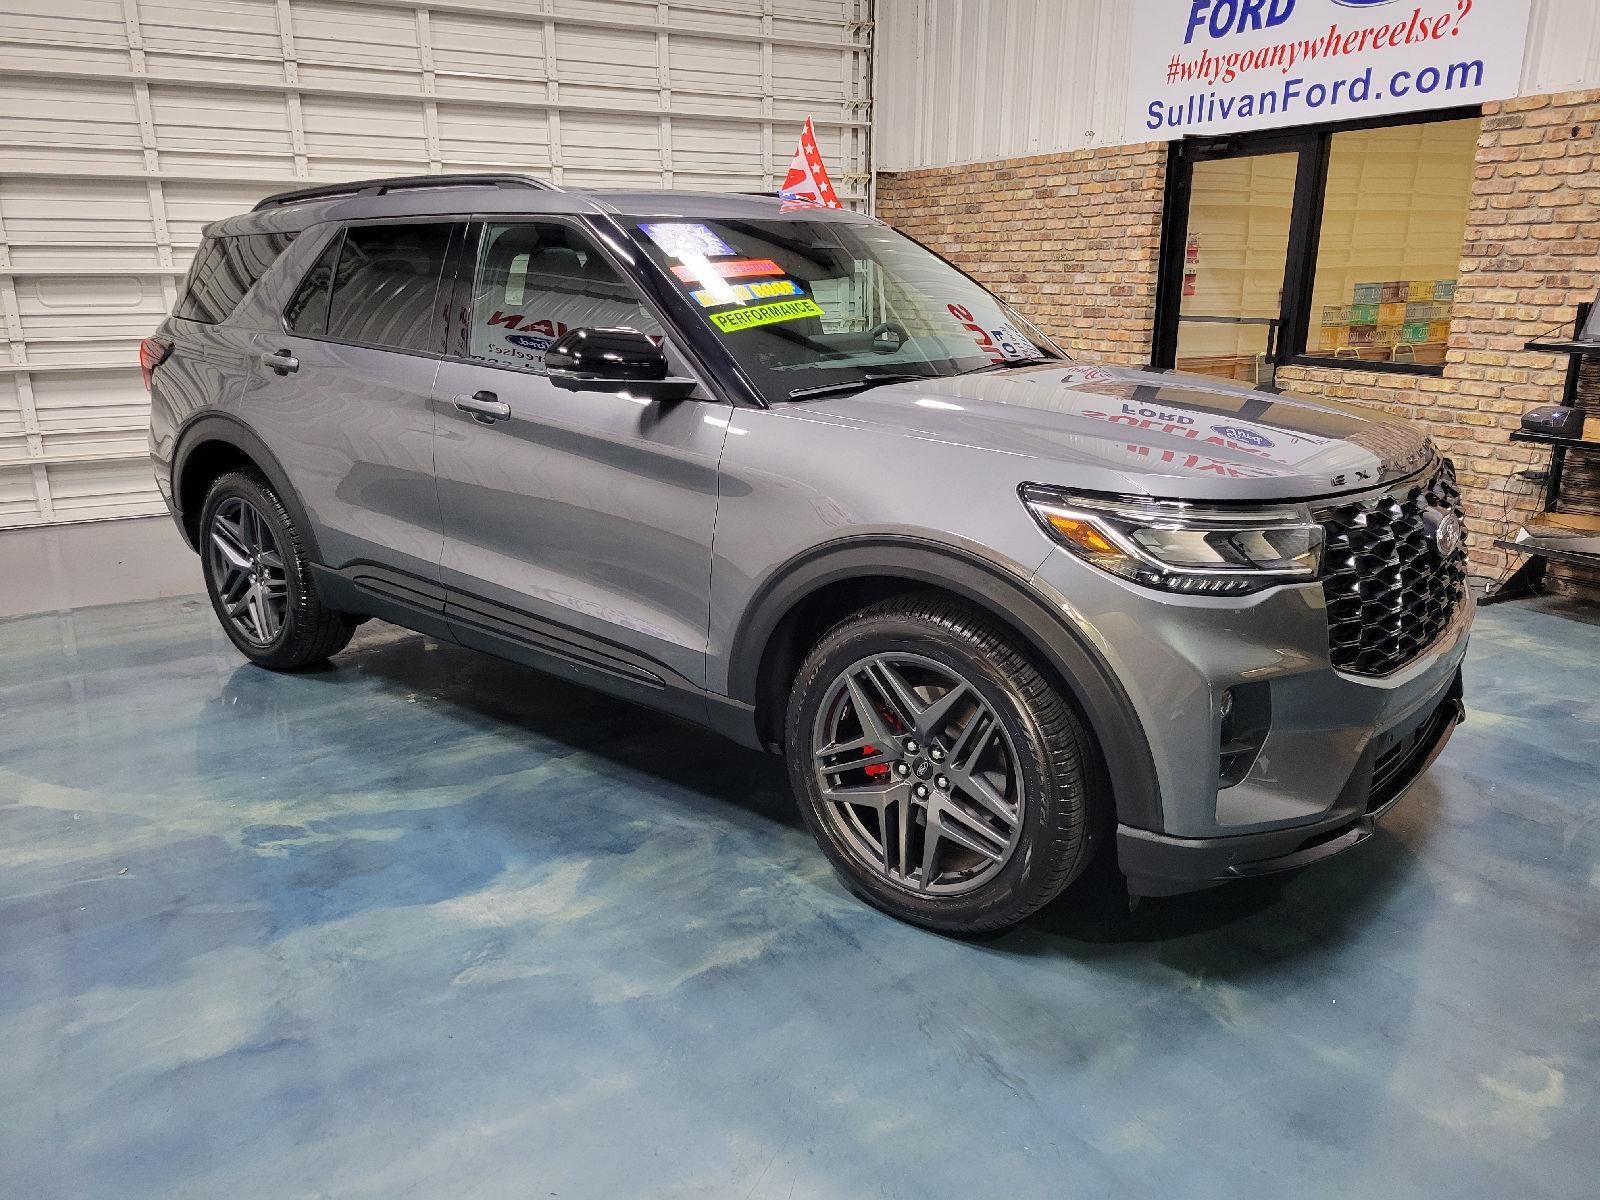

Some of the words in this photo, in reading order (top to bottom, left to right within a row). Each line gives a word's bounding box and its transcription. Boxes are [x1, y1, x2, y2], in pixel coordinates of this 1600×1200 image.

[1166, 0, 1472, 86] #whygoanywhereelse?
[1184, 0, 1296, 44] FORD
[1146, 58, 1485, 130] SullivanFord.com
[716, 302, 815, 328] PERFORMANCE
